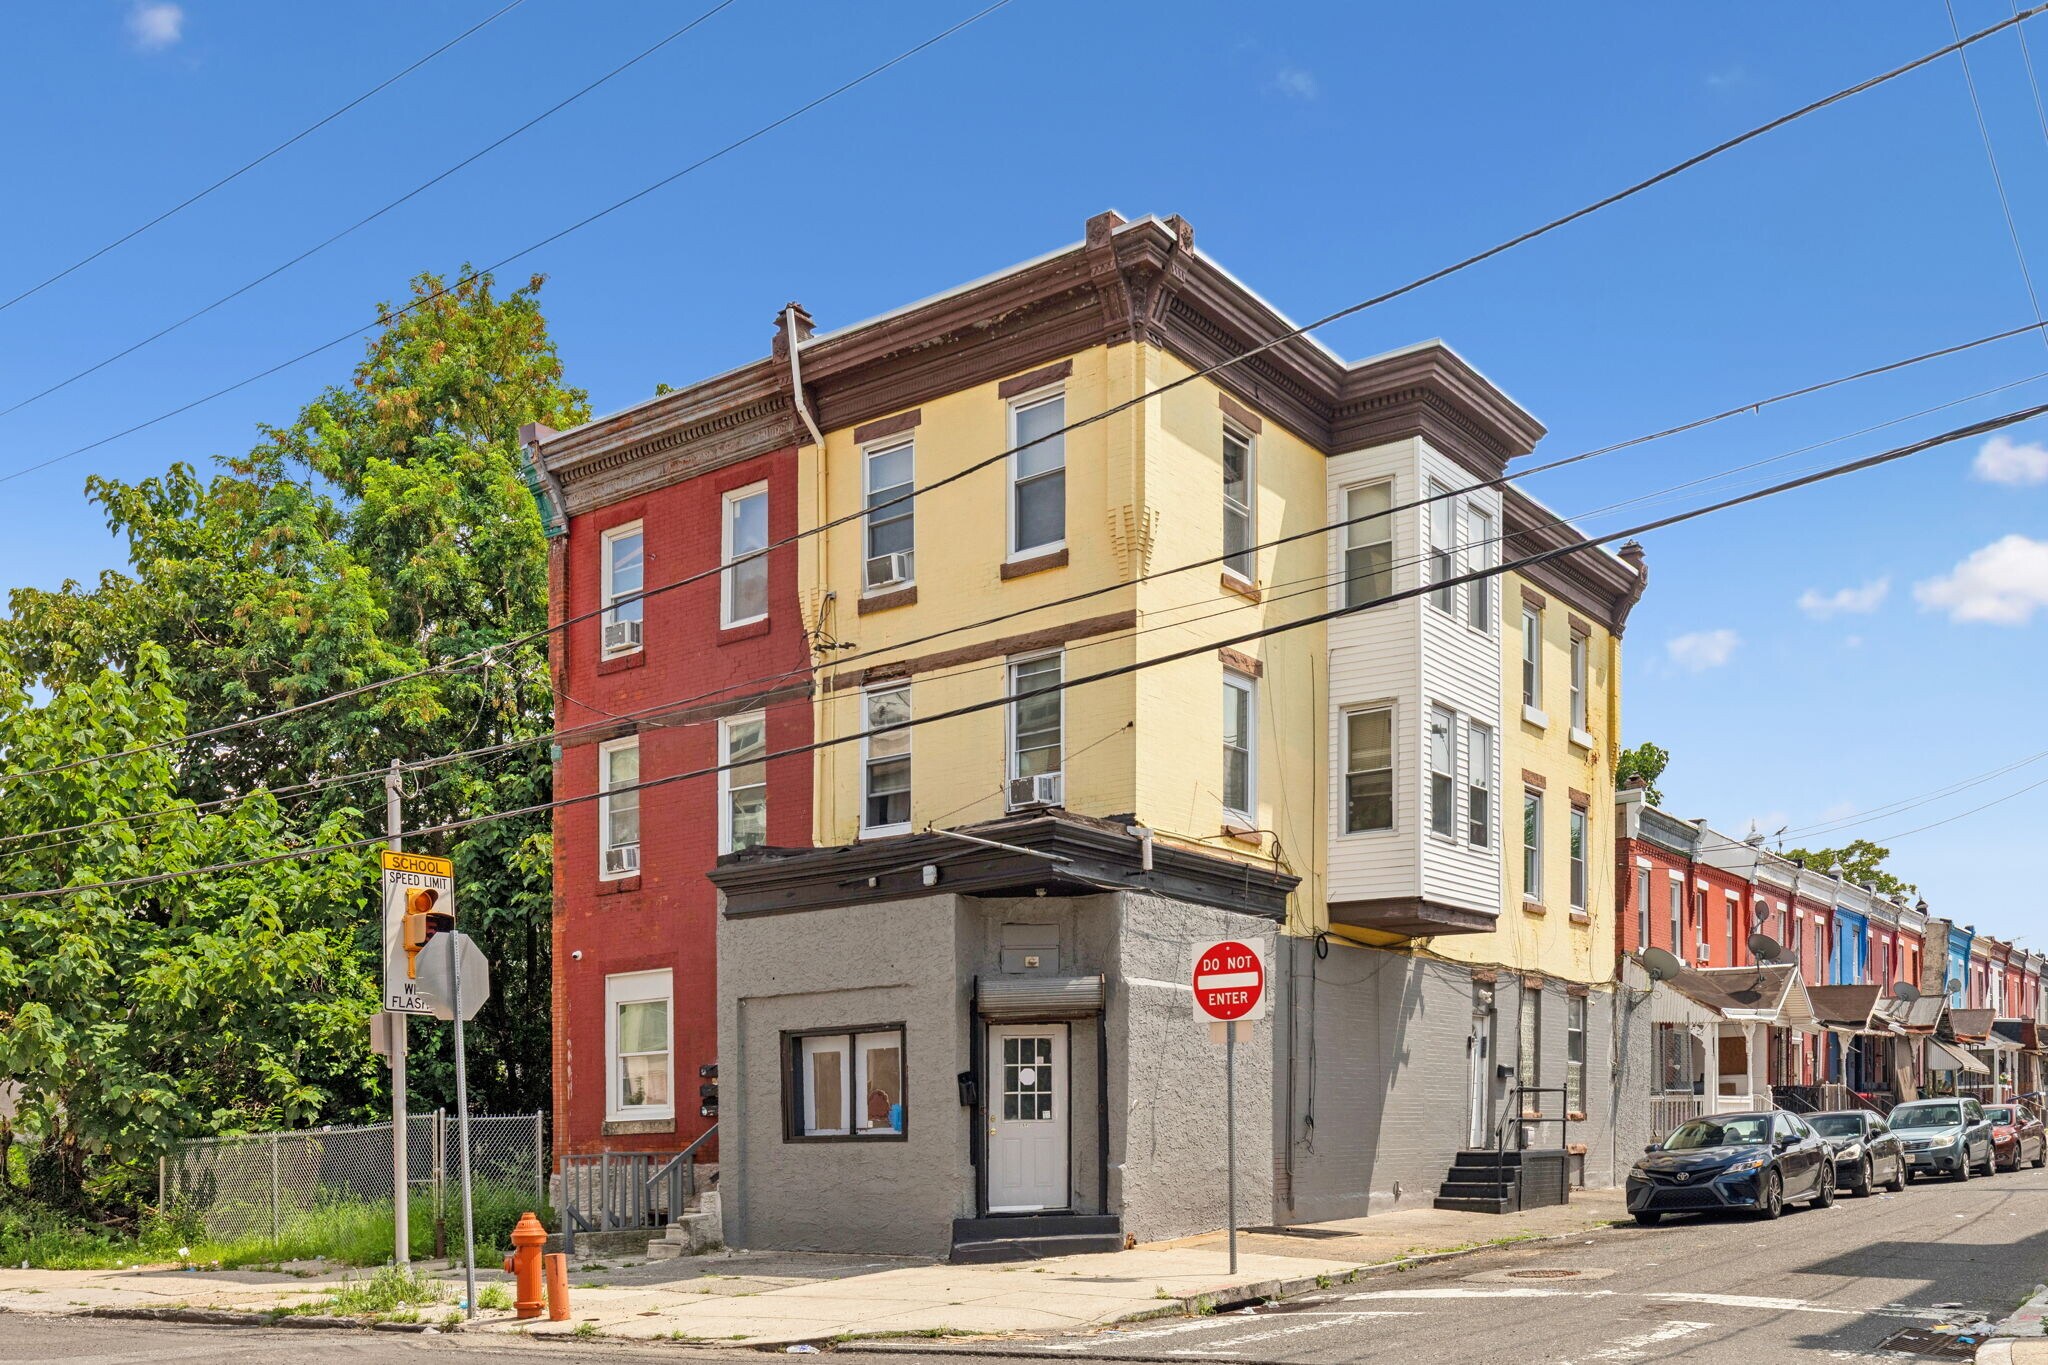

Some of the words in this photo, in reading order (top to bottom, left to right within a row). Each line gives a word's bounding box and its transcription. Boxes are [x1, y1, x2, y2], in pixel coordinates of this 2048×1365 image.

[392, 857, 443, 874] SCHOOL
[389, 871, 420, 886] SPEED
[424, 876, 447, 890] LIMIT
[1203, 958, 1220, 972] DO
[1227, 955, 1252, 970] NOT
[1208, 991, 1248, 1006] ENTER
